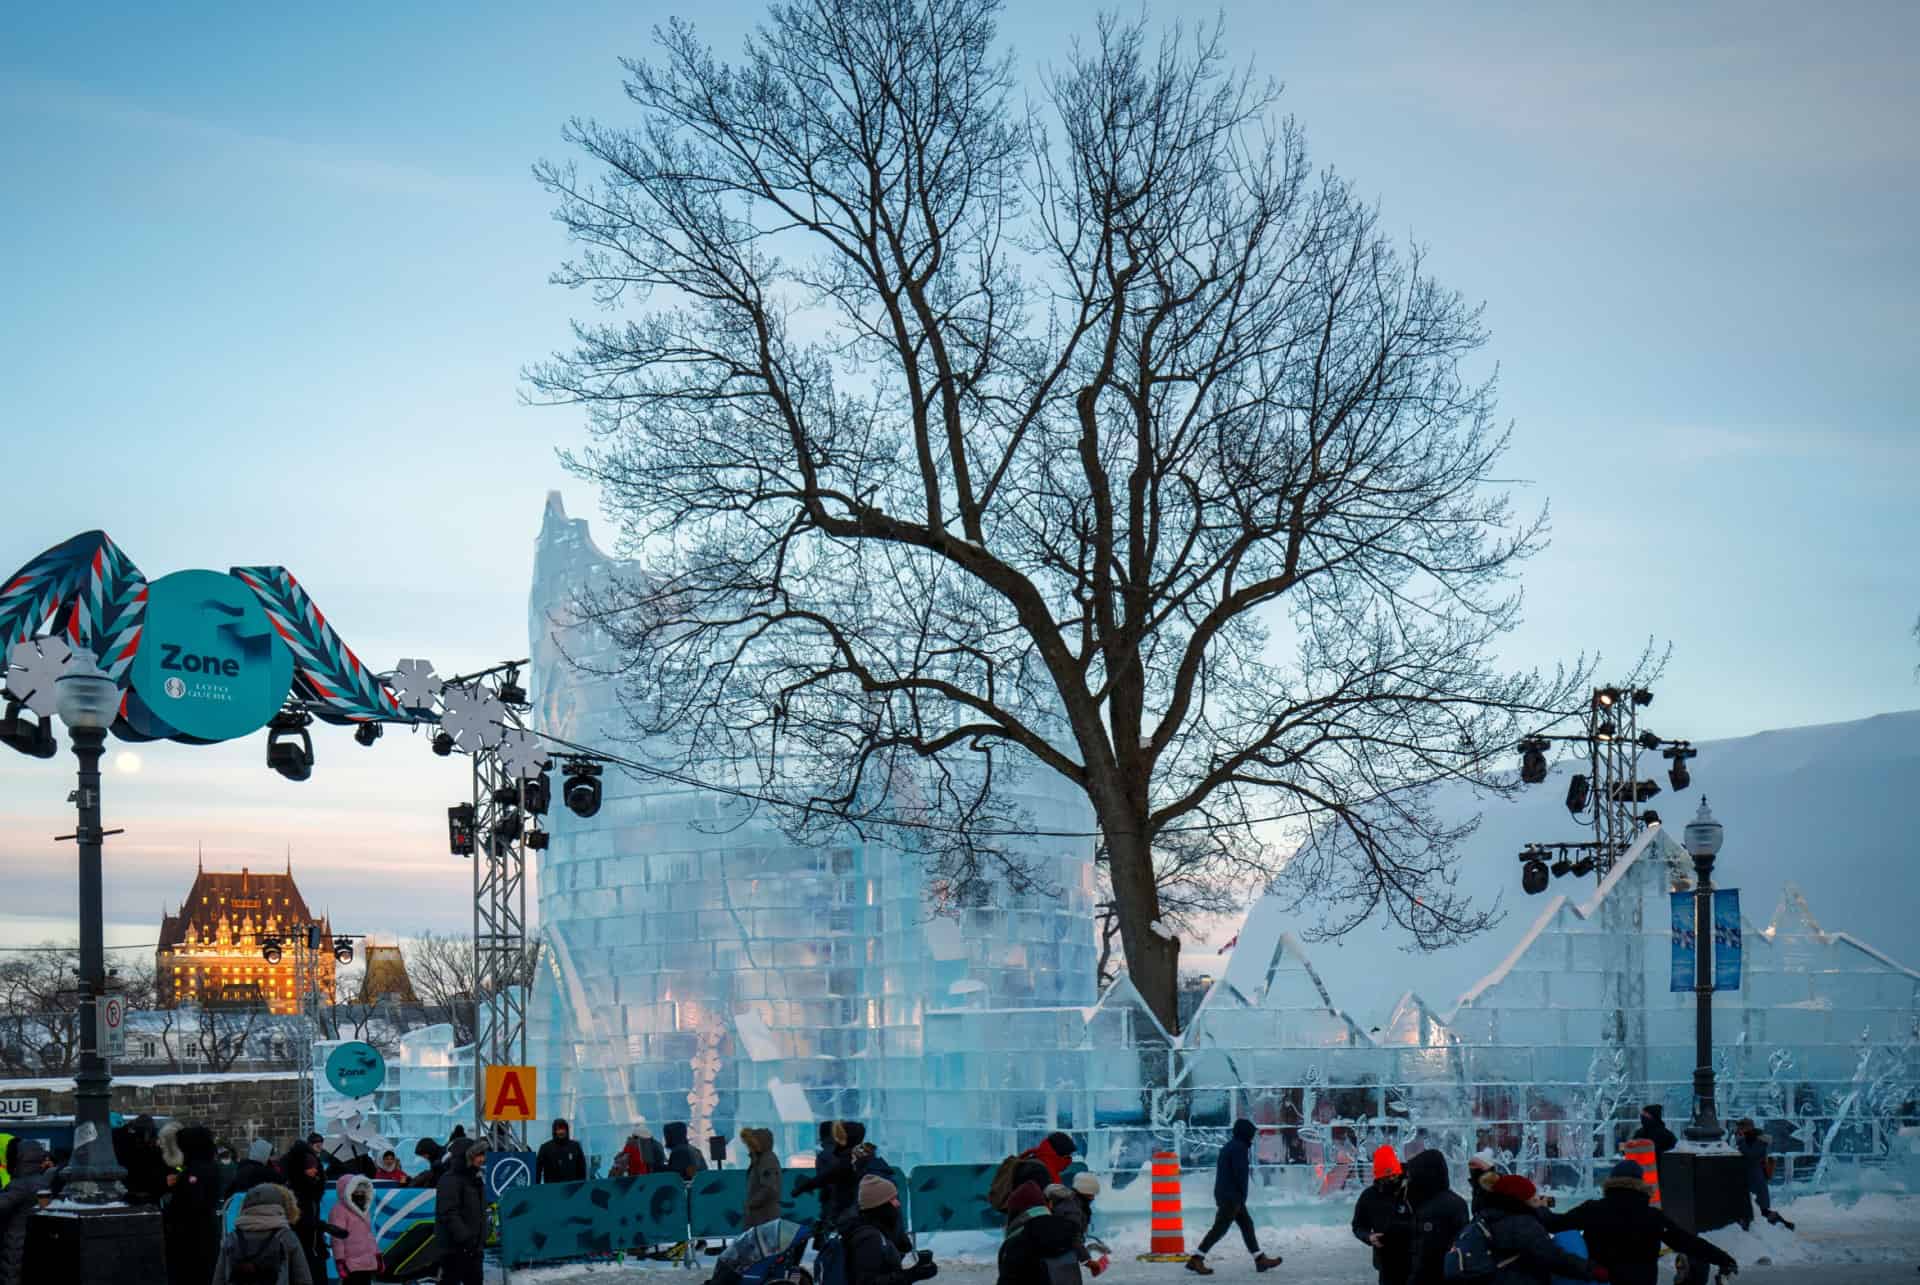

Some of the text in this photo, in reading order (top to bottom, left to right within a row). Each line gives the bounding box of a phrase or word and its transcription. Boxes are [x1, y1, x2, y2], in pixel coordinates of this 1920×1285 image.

[161, 644, 240, 677] Zone
[338, 1067, 366, 1077] Zone
[493, 1071, 530, 1115] A
